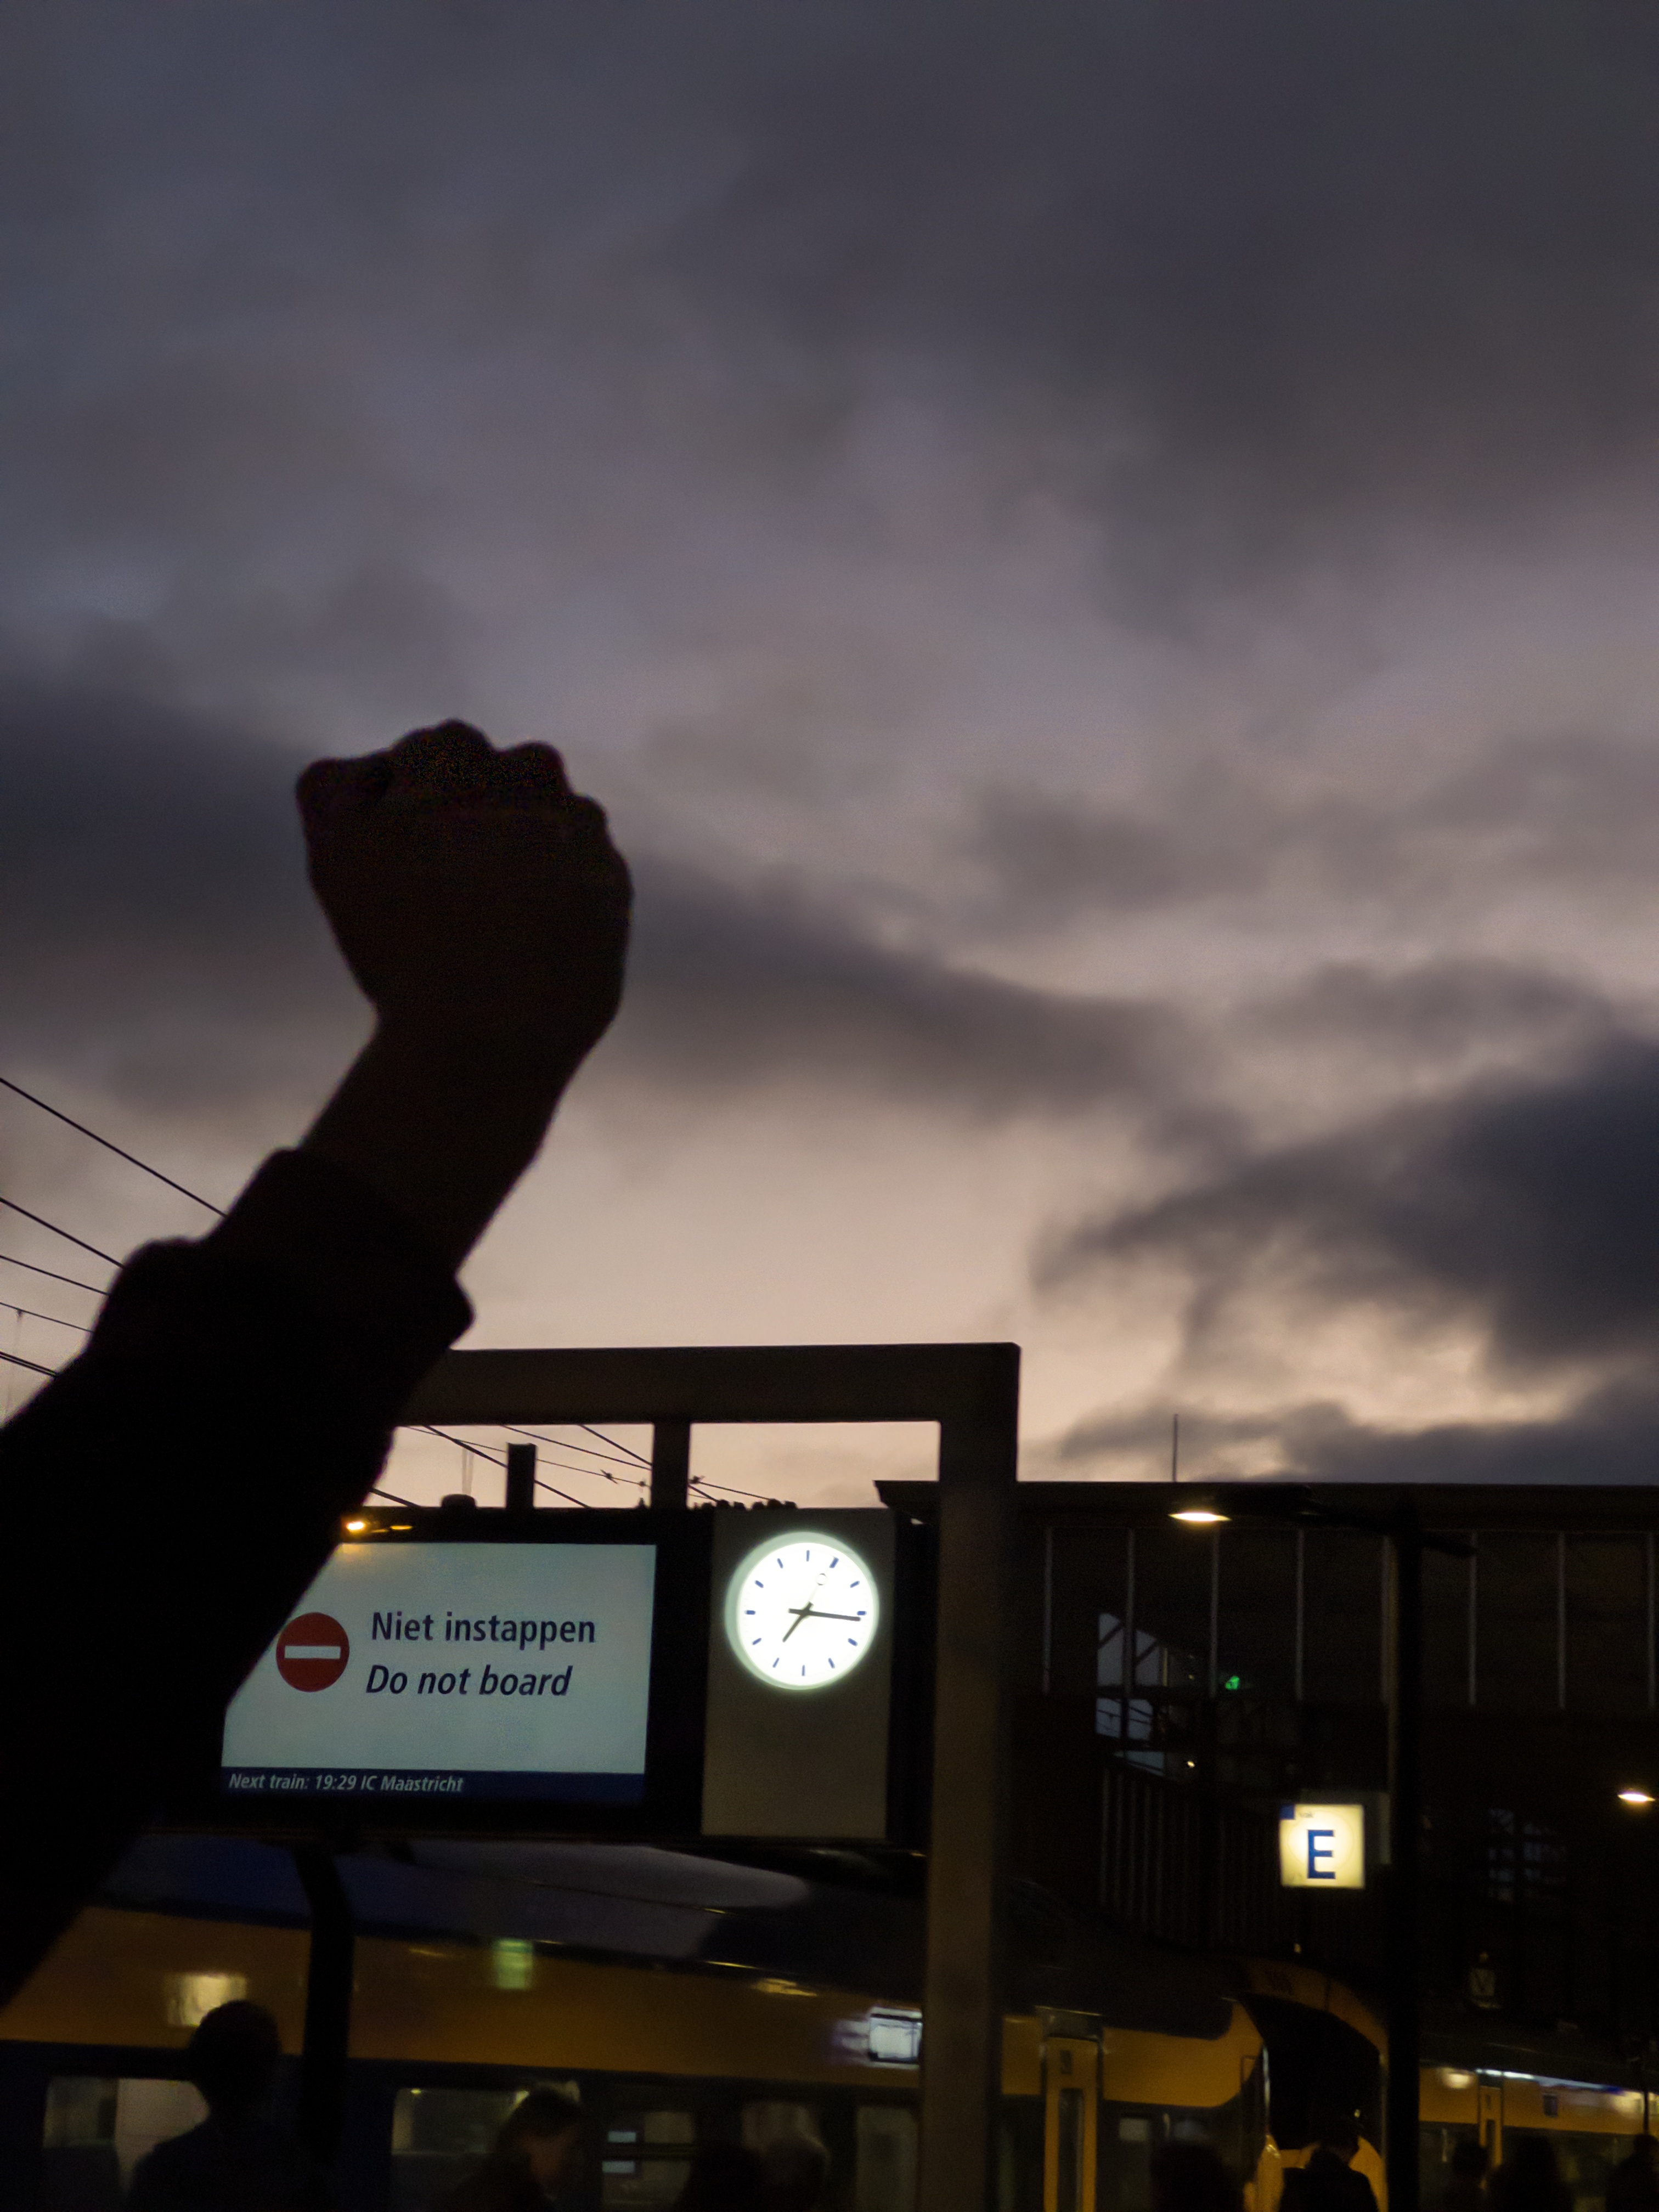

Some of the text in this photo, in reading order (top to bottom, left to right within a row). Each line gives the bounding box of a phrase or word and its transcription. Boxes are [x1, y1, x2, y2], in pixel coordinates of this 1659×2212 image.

[371, 1610, 596, 1651] Niet instappen
[365, 1663, 574, 1697] Do not board
[228, 1773, 464, 1792] Next train: 19:29 IC Maastricht
[1306, 1829, 1336, 1880] E
